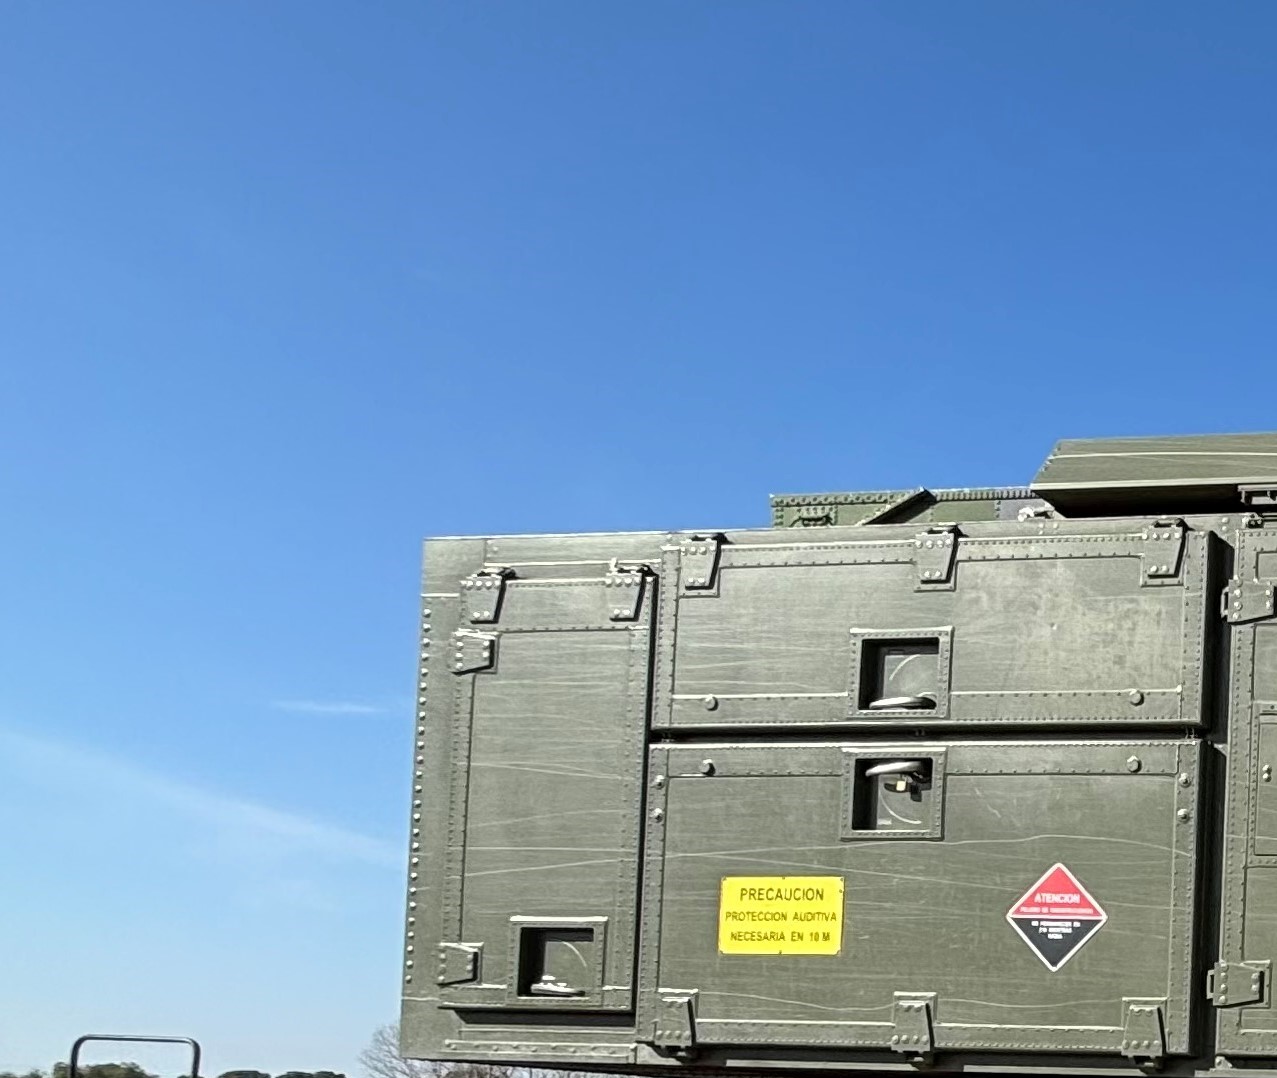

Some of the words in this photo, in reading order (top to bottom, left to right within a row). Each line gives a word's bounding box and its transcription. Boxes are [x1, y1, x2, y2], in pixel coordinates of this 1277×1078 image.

[740, 888, 824, 901] PRECAUCION
[1034, 893, 1080, 904] ATENCION
[725, 911, 787, 922] PROTECCION
[793, 912, 837, 922] AUDITIVA
[730, 931, 786, 942] NECESARIA
[791, 931, 804, 942] EN
